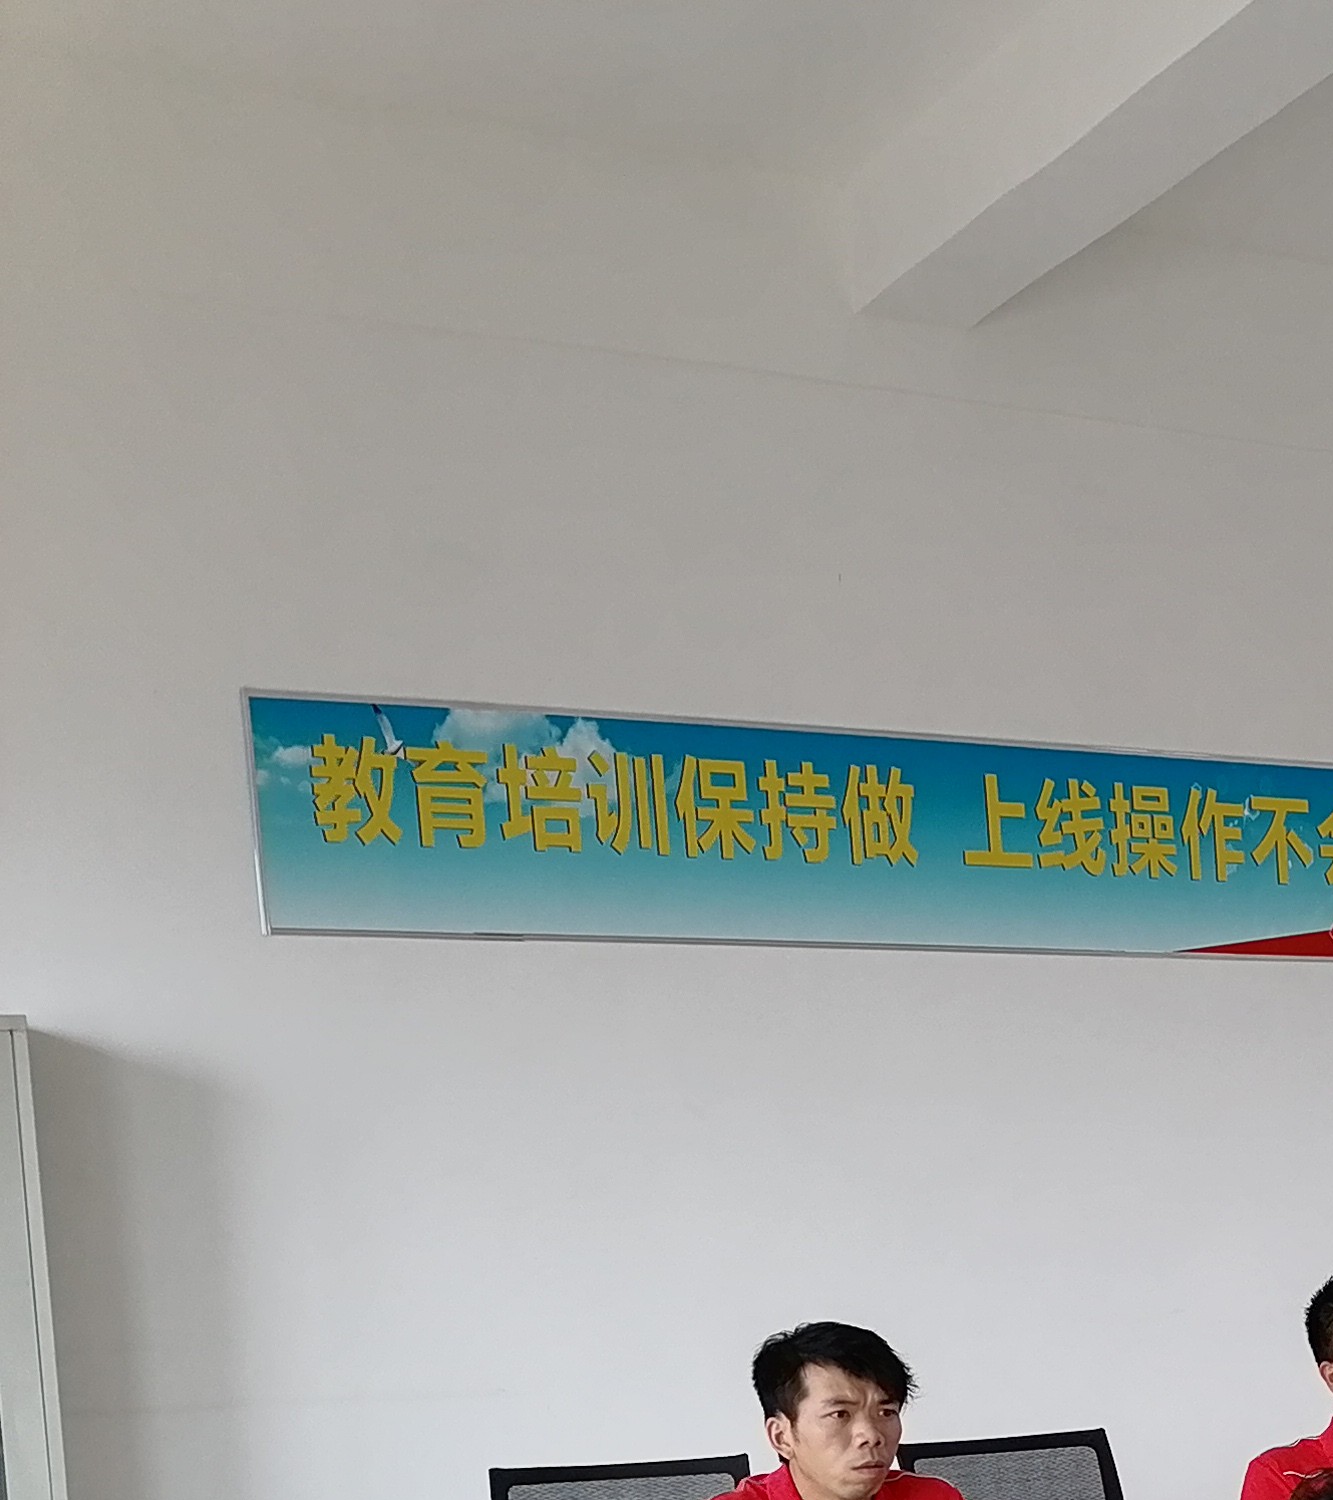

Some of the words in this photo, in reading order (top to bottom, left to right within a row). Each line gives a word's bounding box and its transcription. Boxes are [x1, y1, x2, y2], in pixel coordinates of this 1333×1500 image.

[309, 734, 918, 867] 教育培训保持做
